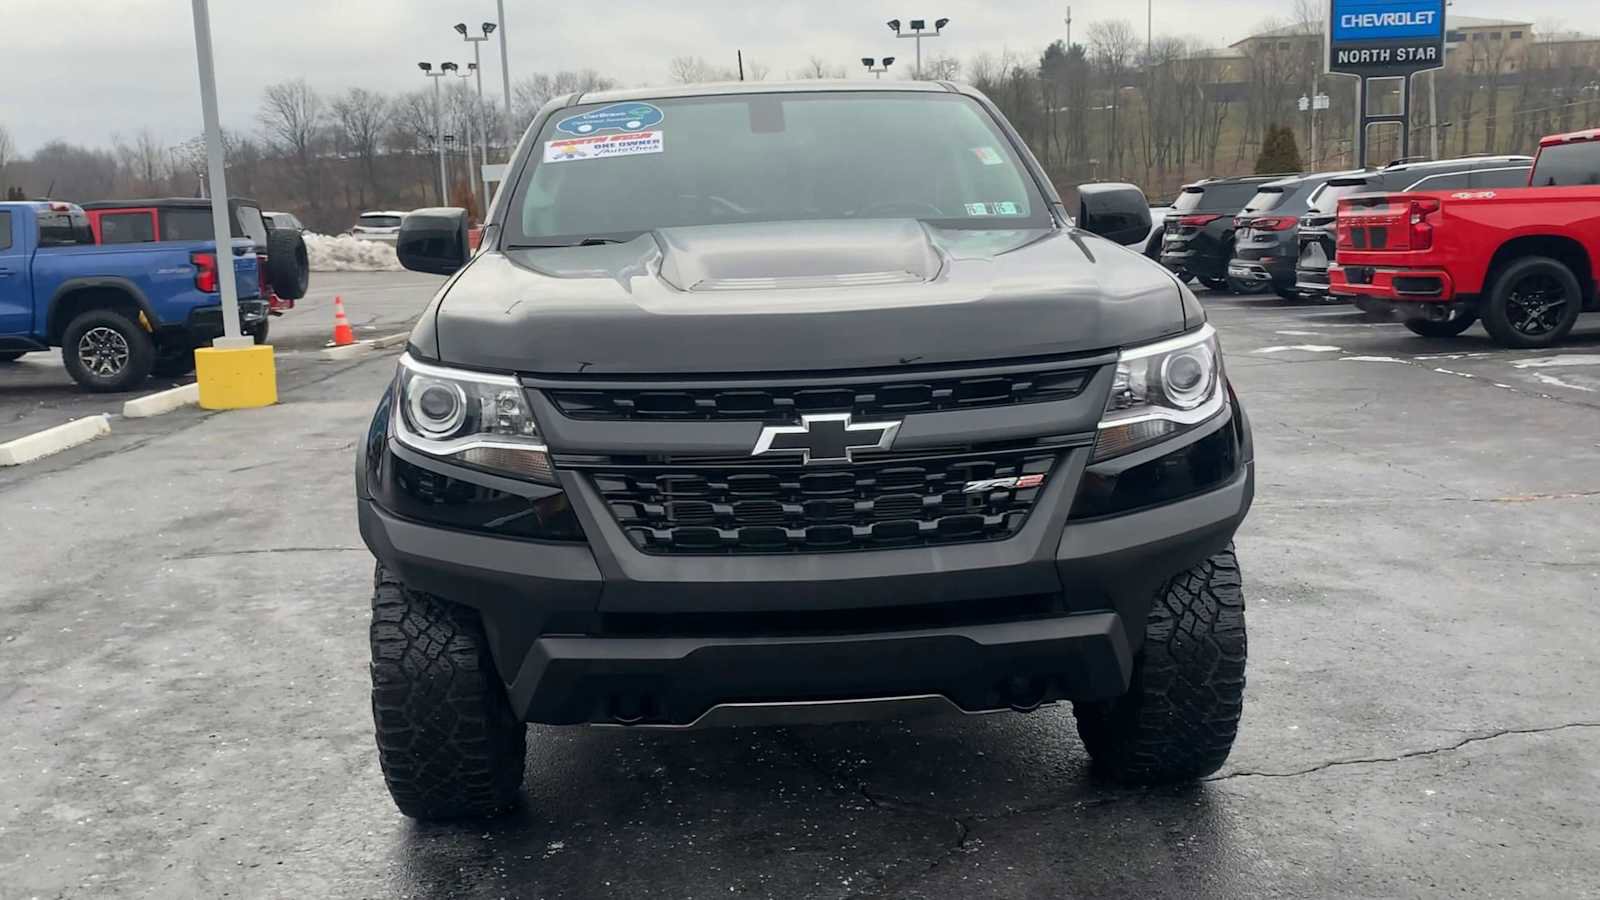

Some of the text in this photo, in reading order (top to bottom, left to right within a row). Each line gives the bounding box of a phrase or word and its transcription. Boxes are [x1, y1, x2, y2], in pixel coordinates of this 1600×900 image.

[1341, 11, 1436, 28] CHEVROLET
[1338, 47, 1436, 63] NORTH STAR
[619, 139, 660, 147] OWNER
